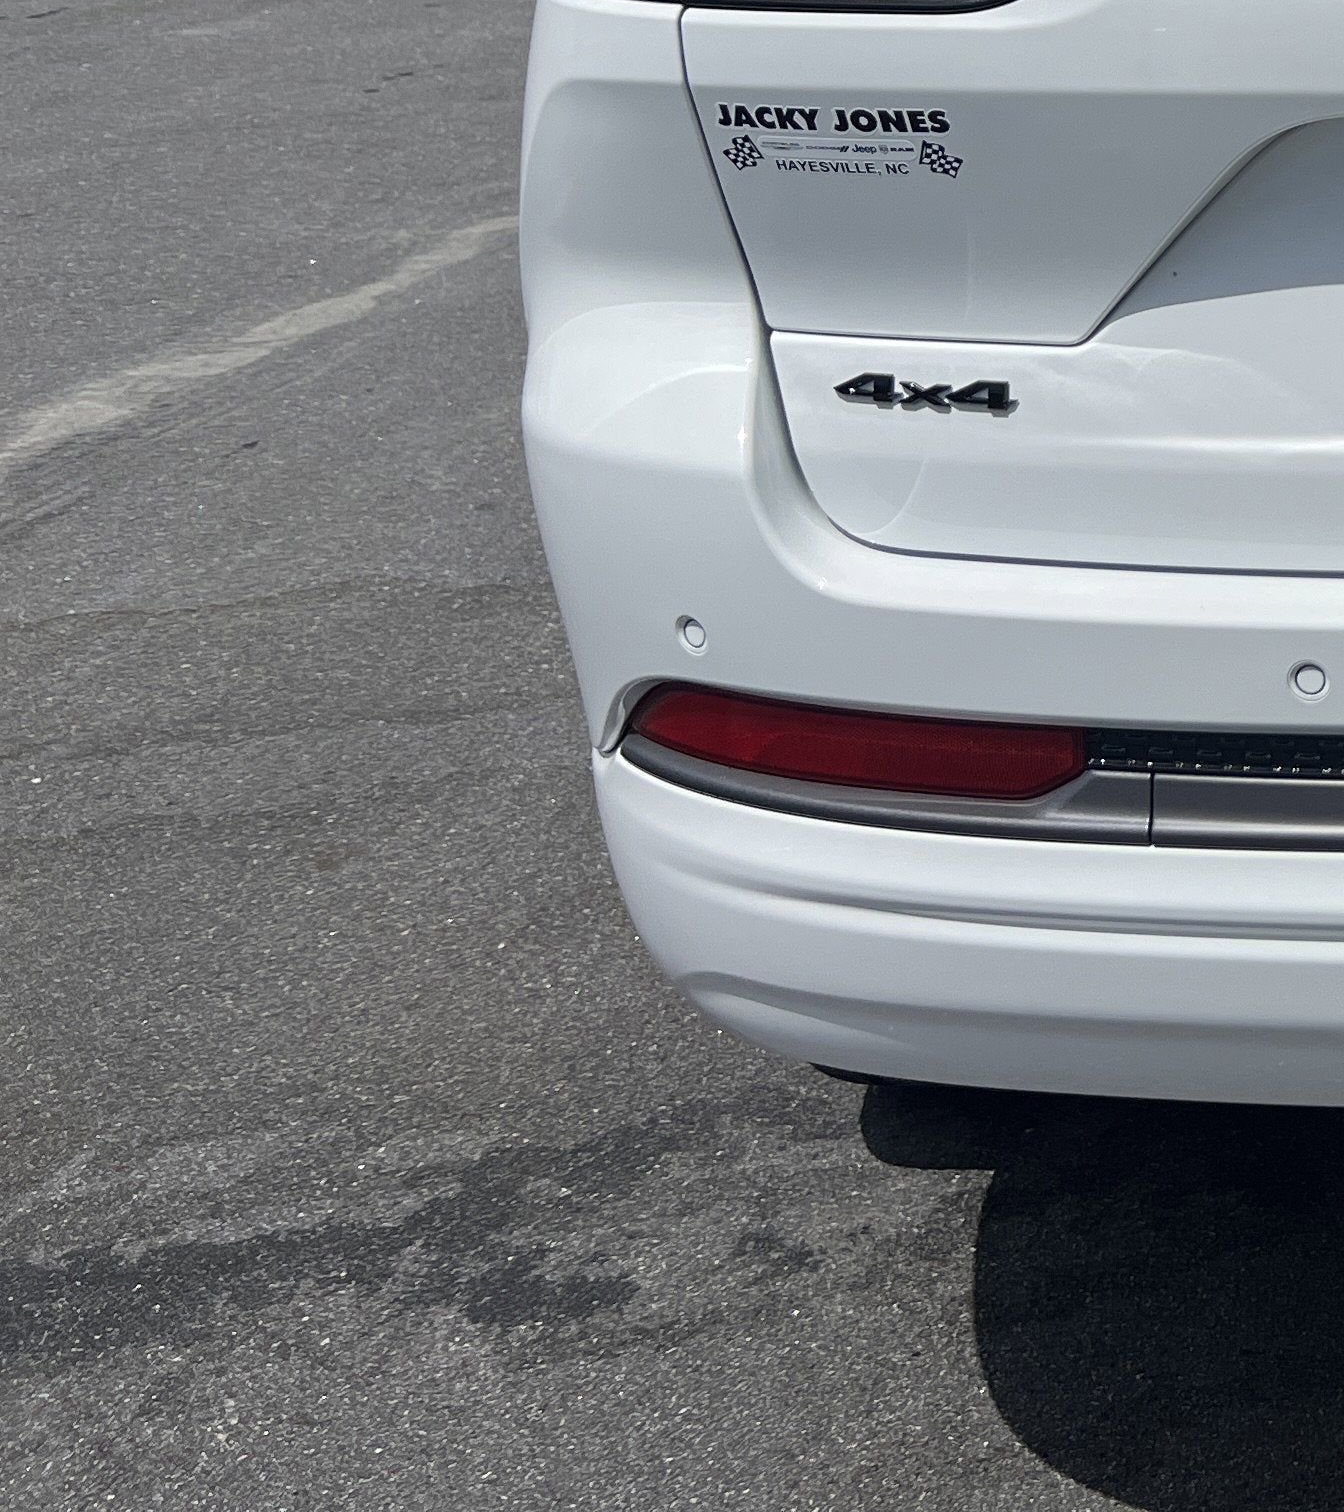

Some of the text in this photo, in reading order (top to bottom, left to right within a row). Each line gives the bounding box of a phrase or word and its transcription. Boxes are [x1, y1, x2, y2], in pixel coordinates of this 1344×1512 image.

[717, 103, 951, 134] JACKY JONES
[851, 143, 877, 155] Jeep
[776, 159, 910, 177] HAYESVILLE, NC
[833, 371, 1016, 414] 4x4
